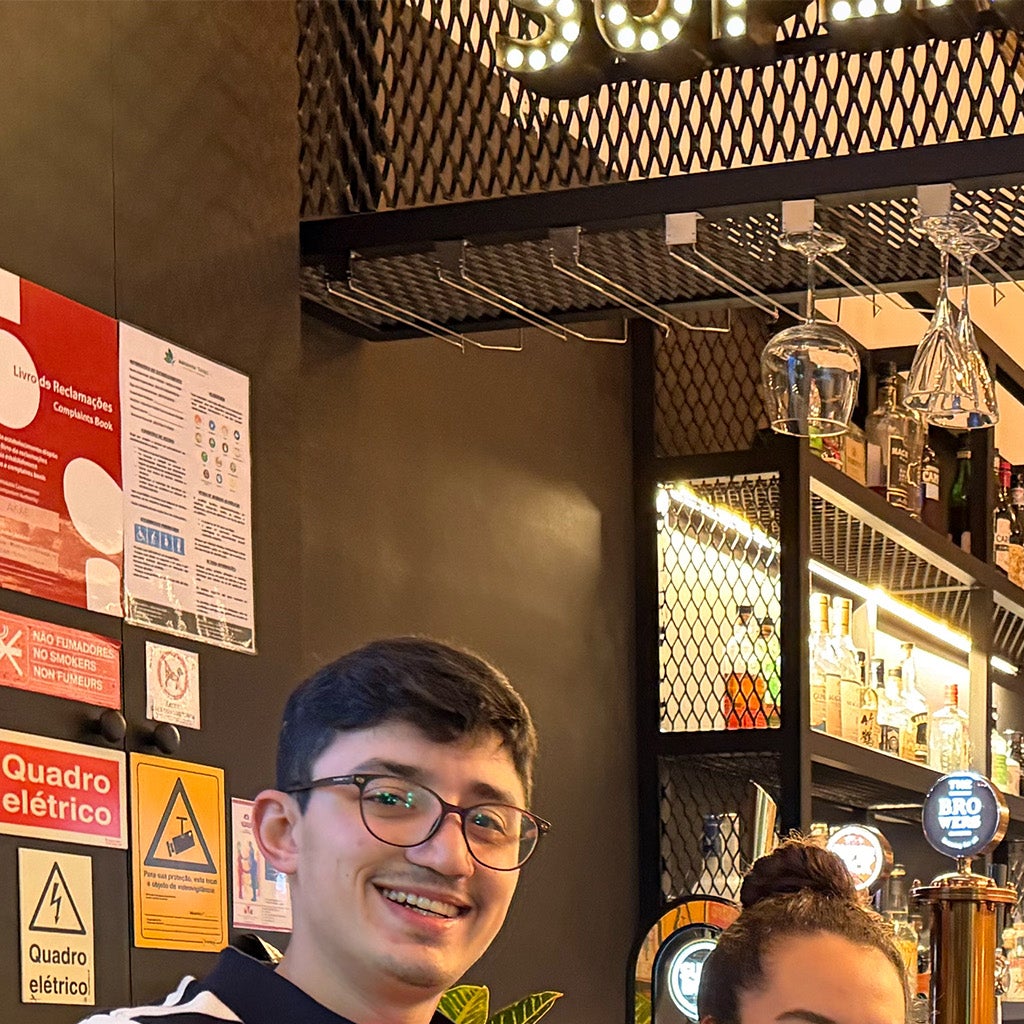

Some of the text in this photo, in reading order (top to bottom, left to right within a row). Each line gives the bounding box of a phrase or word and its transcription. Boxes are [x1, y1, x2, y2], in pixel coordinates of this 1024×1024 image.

[13, 364, 37, 384] Livro
[52, 380, 113, 413] Reclamações
[94, 416, 113, 432] Book
[33, 647, 97, 672] NO SMOKERS
[56, 637, 115, 659] FUMADORES
[33, 666, 103, 691] NON FUMEURS
[2, 753, 111, 794] Quadro
[2, 789, 112, 826] elétrico
[938, 797, 982, 815] BRO
[29, 943, 87, 966] Quadro
[29, 975, 88, 995] elétrico
